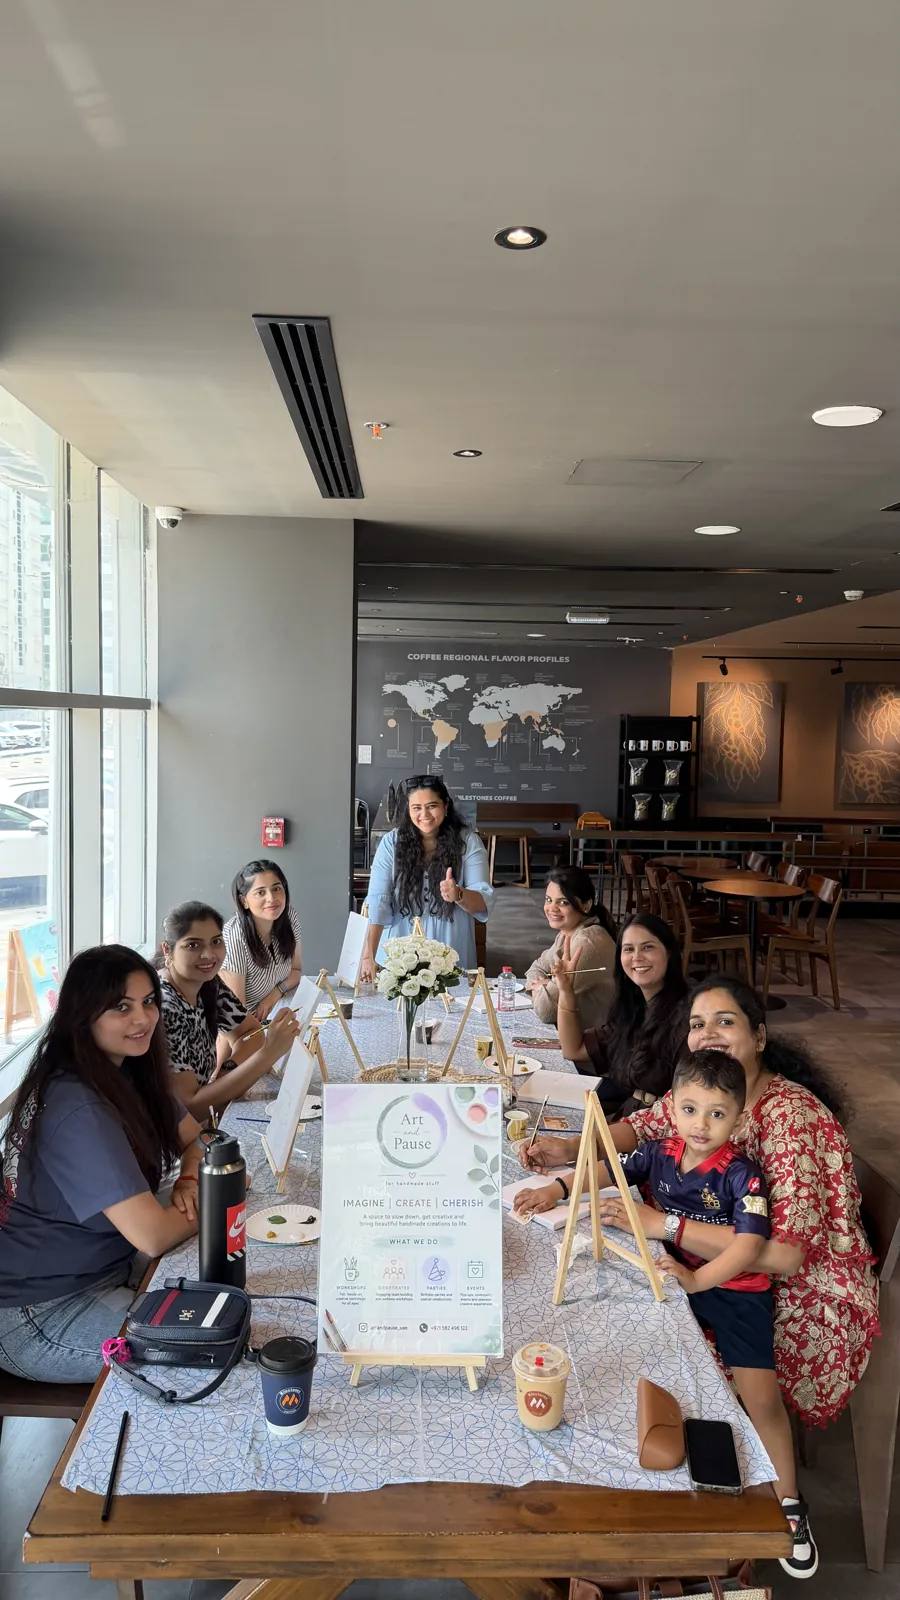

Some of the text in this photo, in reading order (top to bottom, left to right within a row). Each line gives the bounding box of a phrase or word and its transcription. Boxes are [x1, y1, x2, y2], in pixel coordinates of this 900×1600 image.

[407, 653, 441, 661] COFFEE
[443, 654, 489, 662] REGIONAL
[400, 1113, 425, 1125] Art
[403, 1127, 420, 1136] and
[394, 1137, 432, 1150] Pause
[343, 1199, 484, 1207] IMAGINE CREATE CHERISH
